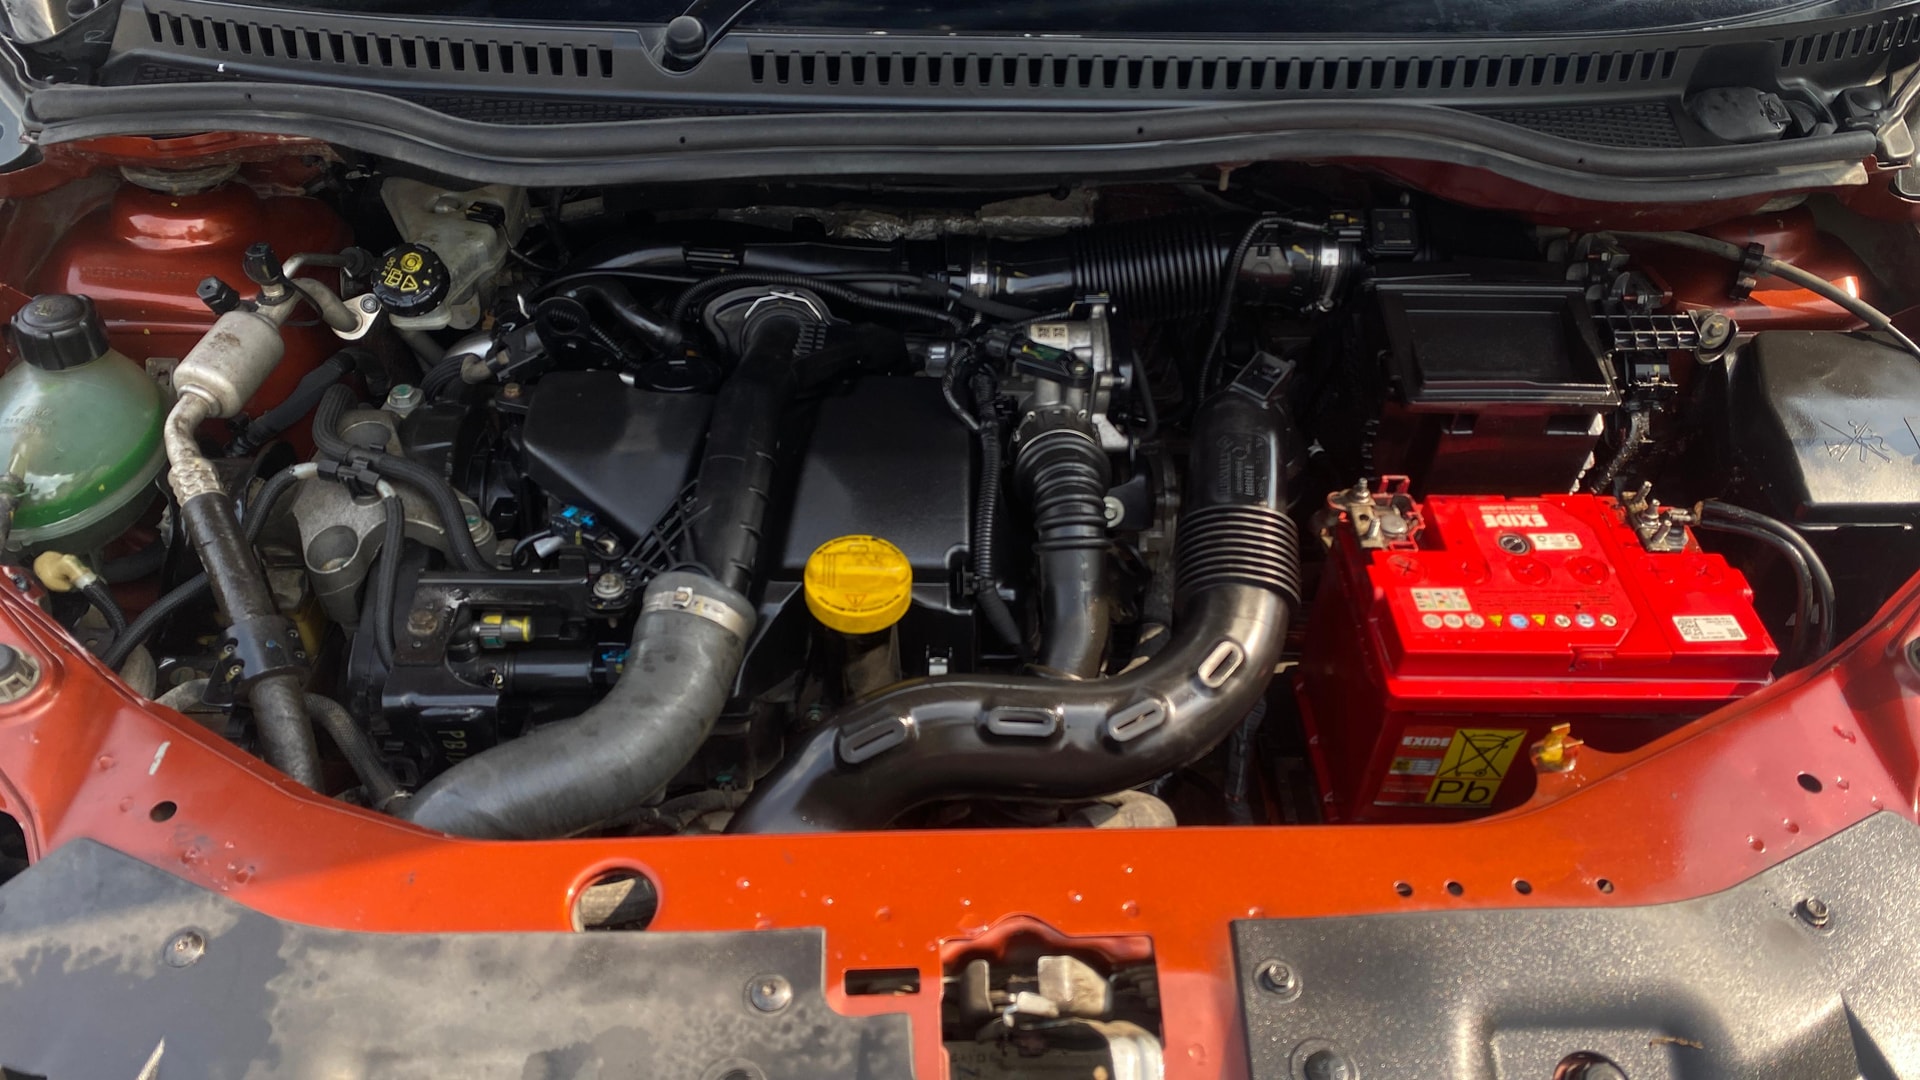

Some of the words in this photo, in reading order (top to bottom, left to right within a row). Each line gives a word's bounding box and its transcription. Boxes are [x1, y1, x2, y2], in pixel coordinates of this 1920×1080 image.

[1481, 513, 1548, 528] EXIDE
[1402, 735, 1451, 747] EXIDE
[1431, 780, 1490, 803] Pb
